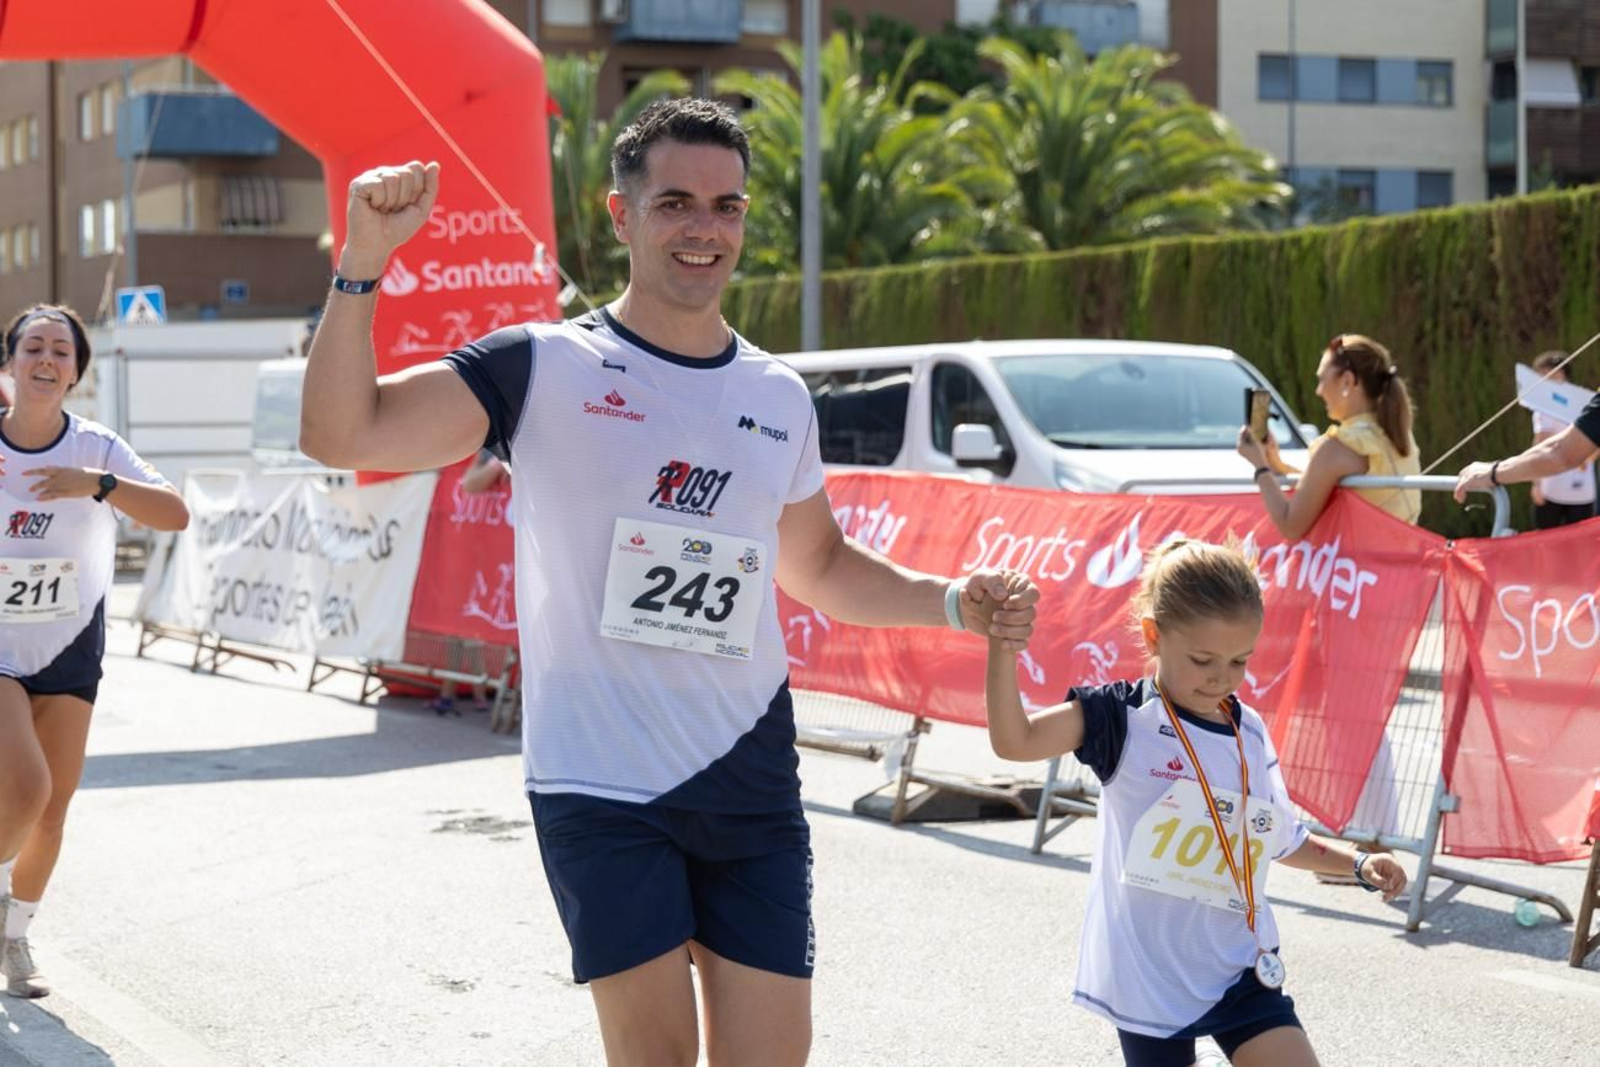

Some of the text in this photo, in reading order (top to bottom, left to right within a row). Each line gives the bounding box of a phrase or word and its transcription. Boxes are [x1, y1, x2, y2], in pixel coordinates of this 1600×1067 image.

[429, 204, 523, 243] Sports
[583, 402, 646, 423] Santander
[961, 516, 1086, 581] Sports
[5, 576, 61, 606] 211
[630, 565, 740, 623] 243
[633, 617, 664, 629] ANTONIO
[664, 622, 694, 635] JIMÉNEZ
